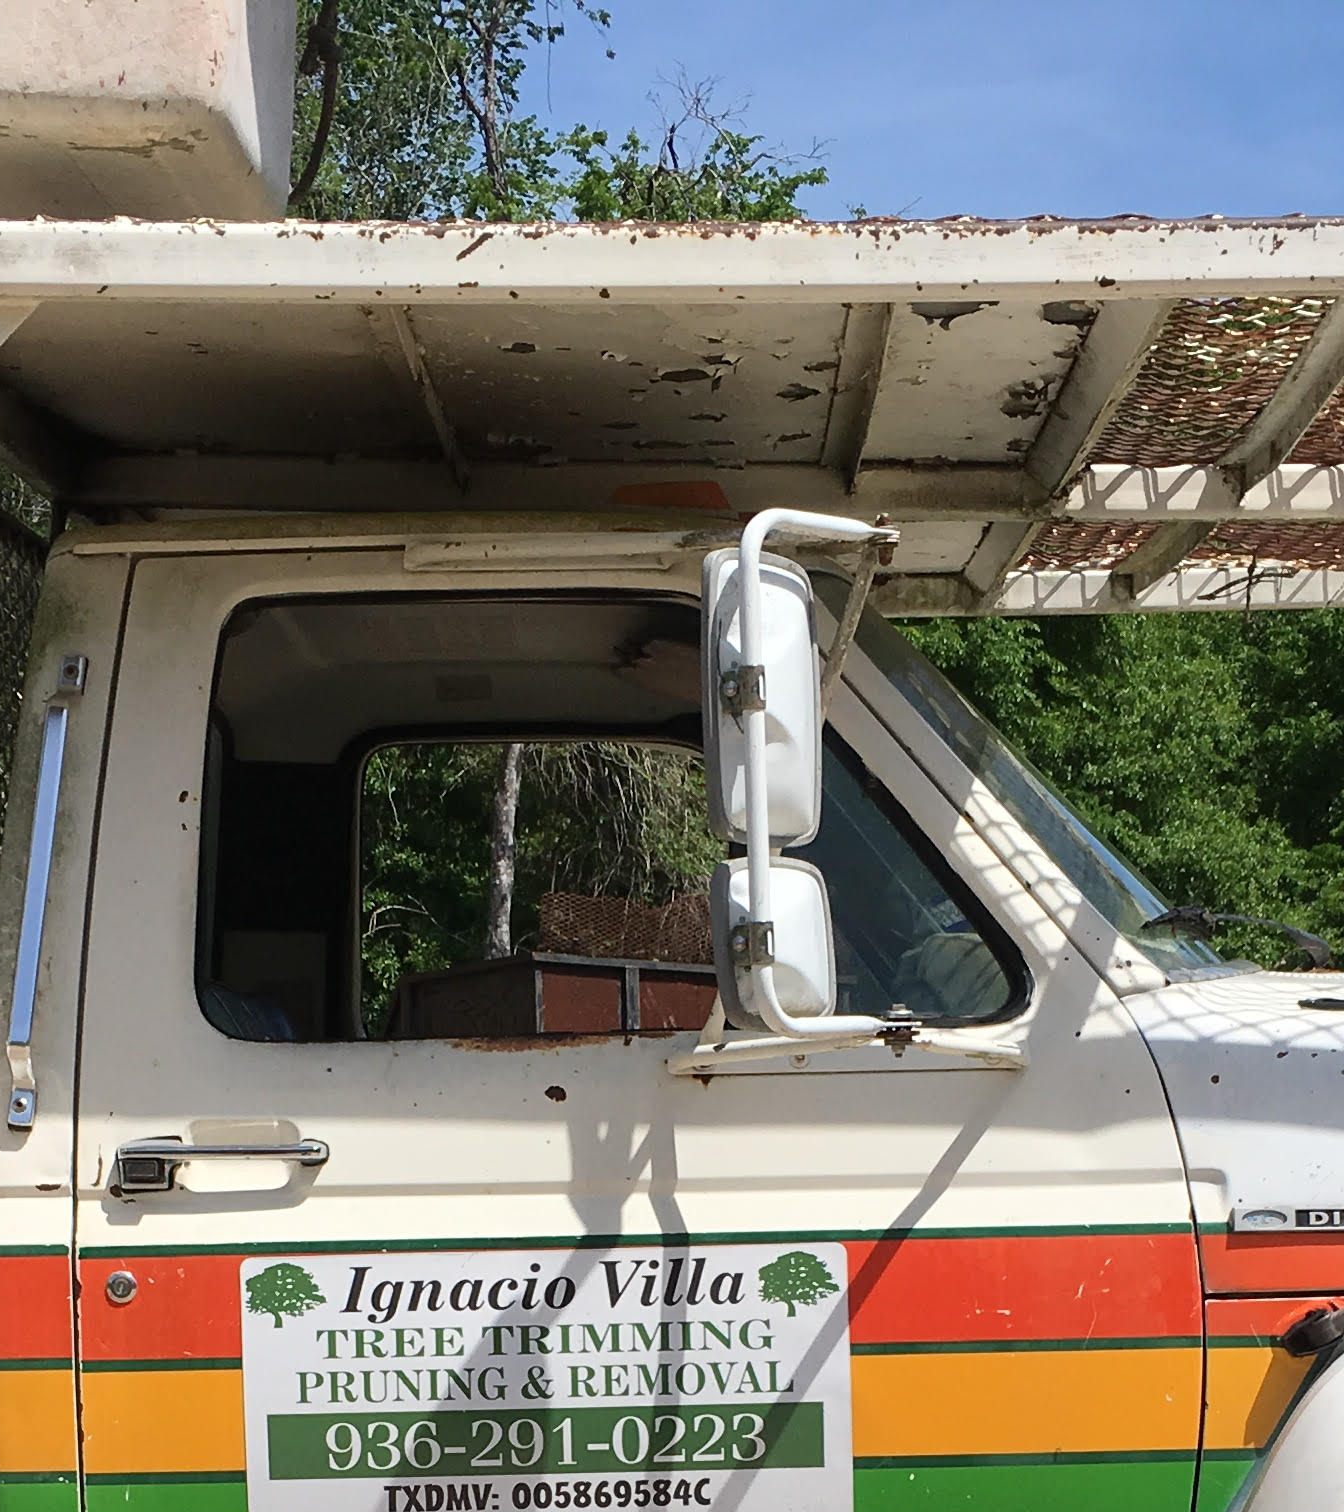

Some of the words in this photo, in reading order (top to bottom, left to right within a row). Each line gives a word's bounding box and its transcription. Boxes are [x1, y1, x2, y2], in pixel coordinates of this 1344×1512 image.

[340, 1263, 576, 1323] Ignacio
[599, 1257, 746, 1308] Villa
[316, 1327, 467, 1360] TREE
[481, 1318, 776, 1355] TRIMMING
[296, 1368, 508, 1405] PRUNING
[520, 1365, 555, 1401] &
[567, 1360, 795, 1398] REMOVAL
[325, 1411, 768, 1473] 936-291-0223
[511, 1478, 712, 1511] 005869584C
